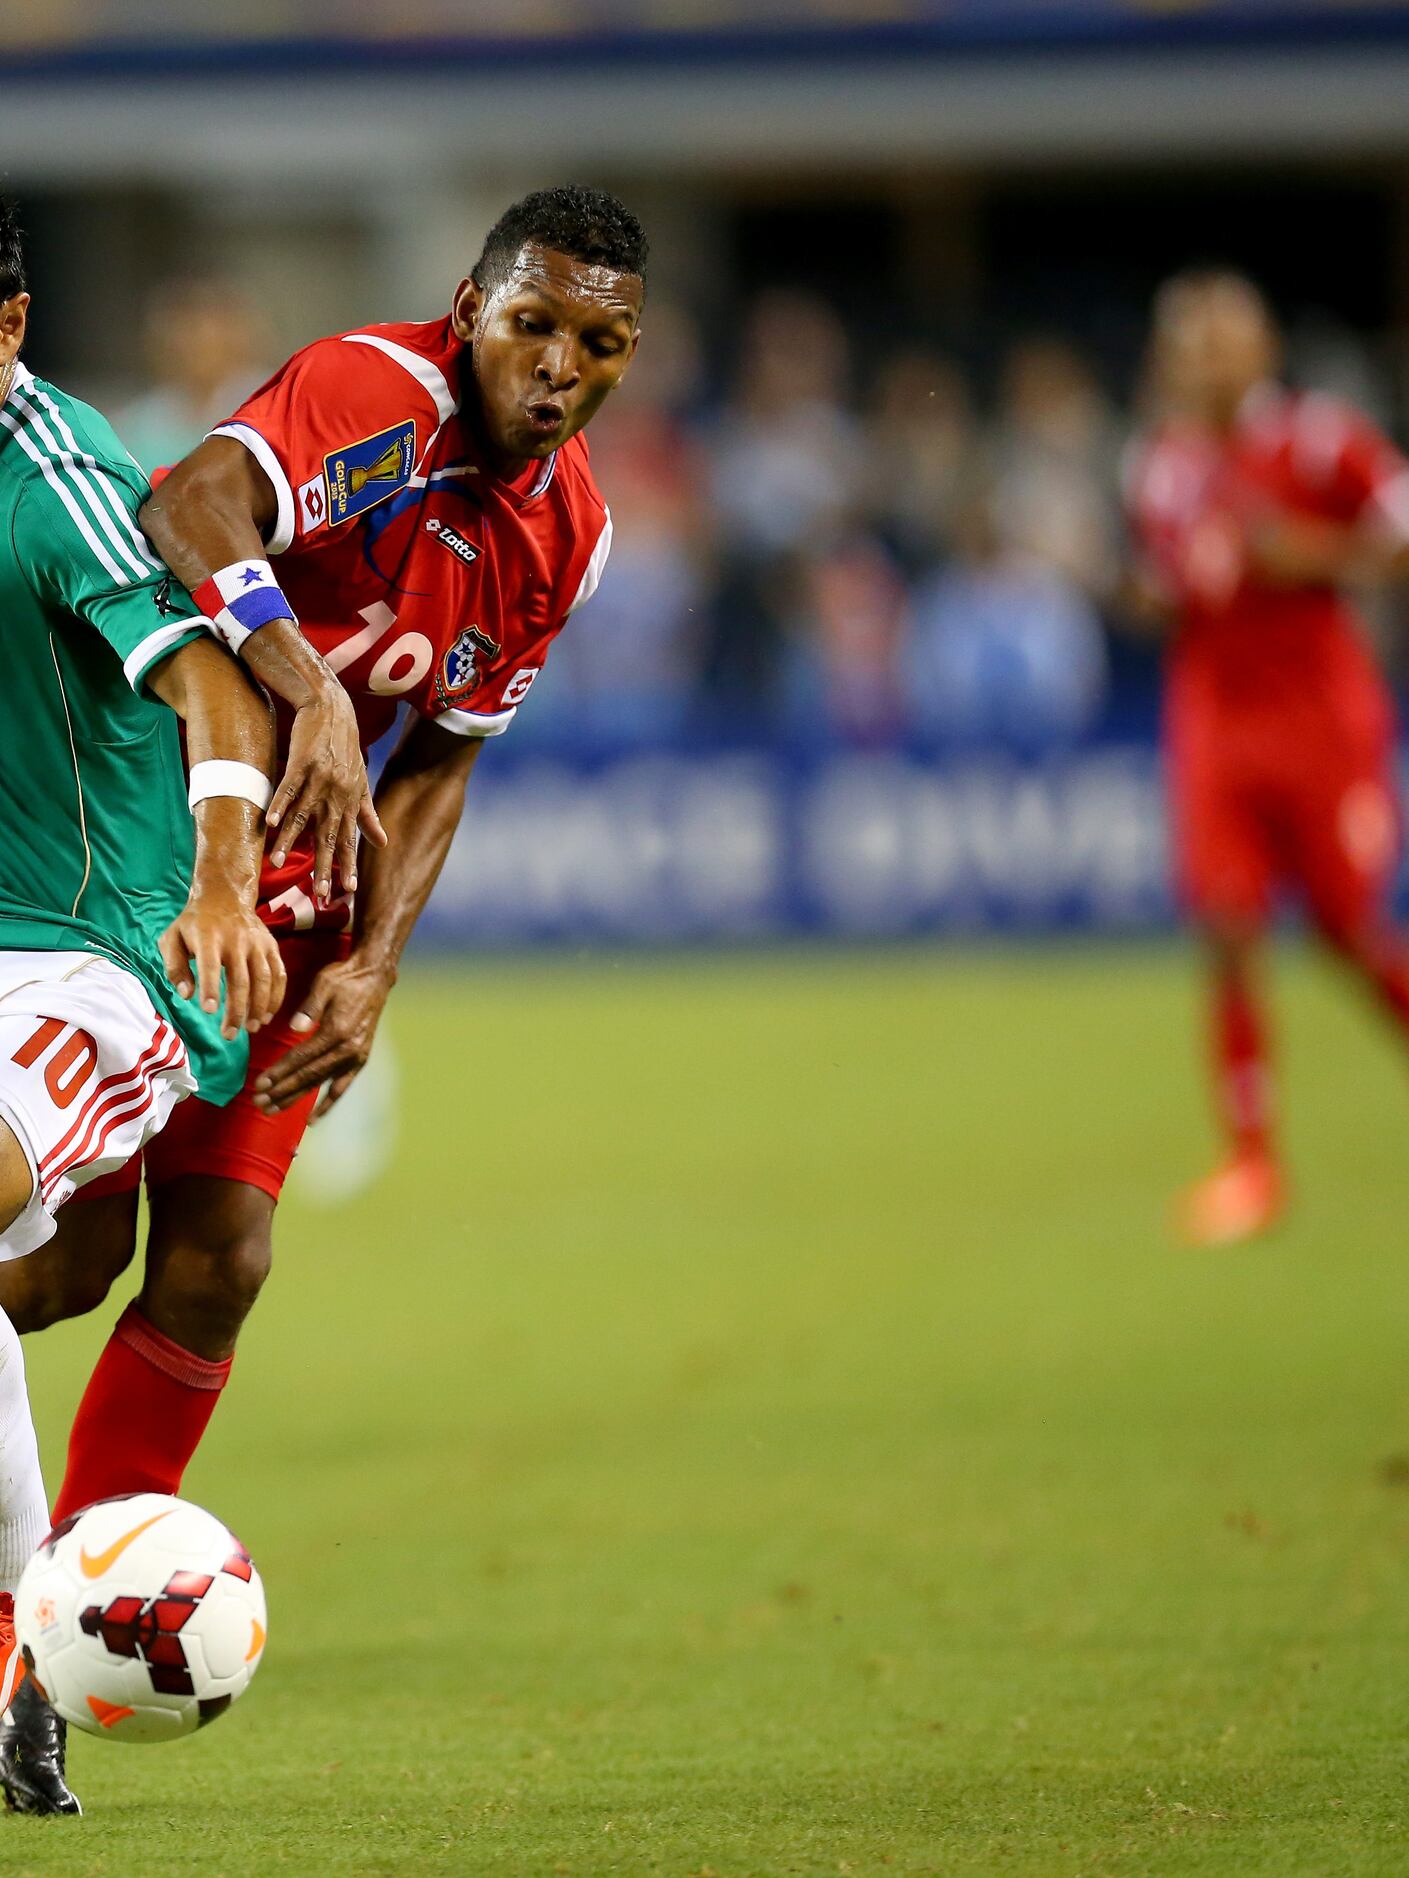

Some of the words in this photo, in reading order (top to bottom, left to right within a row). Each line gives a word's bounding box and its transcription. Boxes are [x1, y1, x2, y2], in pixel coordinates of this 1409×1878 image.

[335, 460, 346, 490] GOLD
[338, 491, 348, 513] CUP
[323, 600, 433, 697] 10
[10, 1014, 98, 1110] 10
